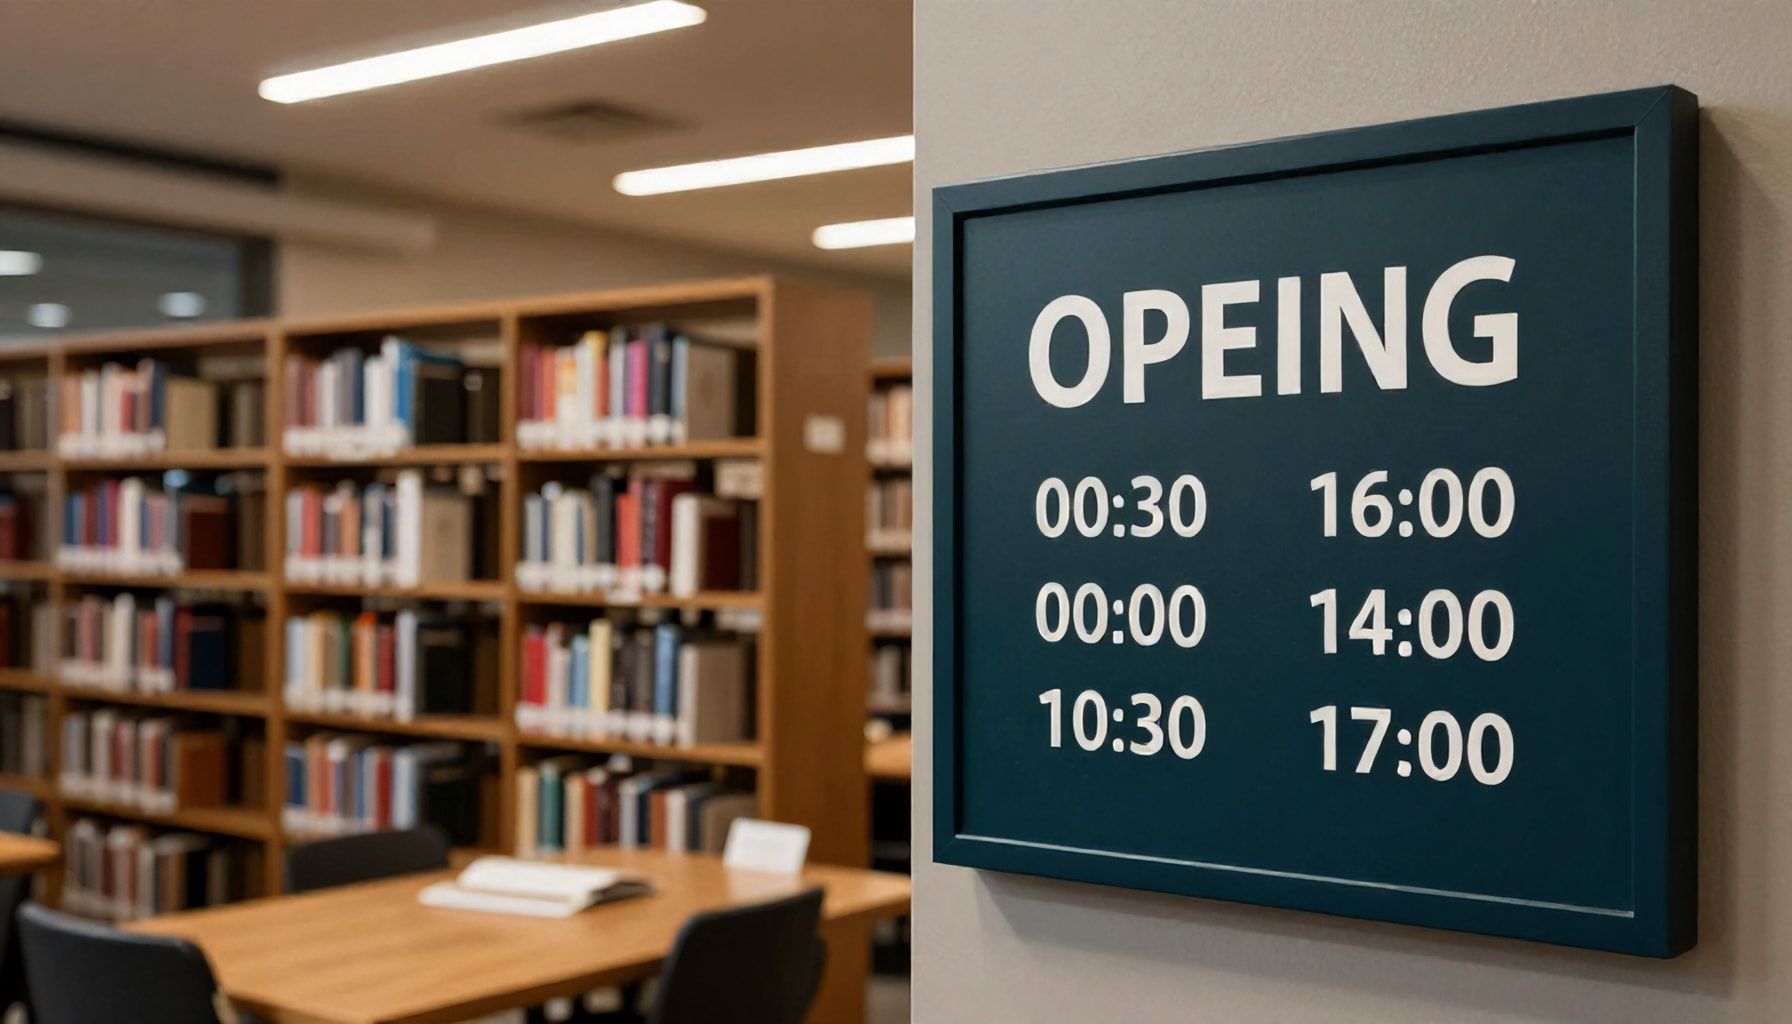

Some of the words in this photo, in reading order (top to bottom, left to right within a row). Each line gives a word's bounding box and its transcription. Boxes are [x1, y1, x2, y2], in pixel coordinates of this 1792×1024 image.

[1028, 255, 1519, 409] OPEING
[1035, 474, 1207, 539] 00:30
[1310, 466, 1515, 539] 16:00
[1035, 581, 1207, 649] 00:00
[1309, 588, 1515, 662] 14:00
[1038, 688, 1207, 760] 10:30
[1310, 705, 1514, 786] 17:00
